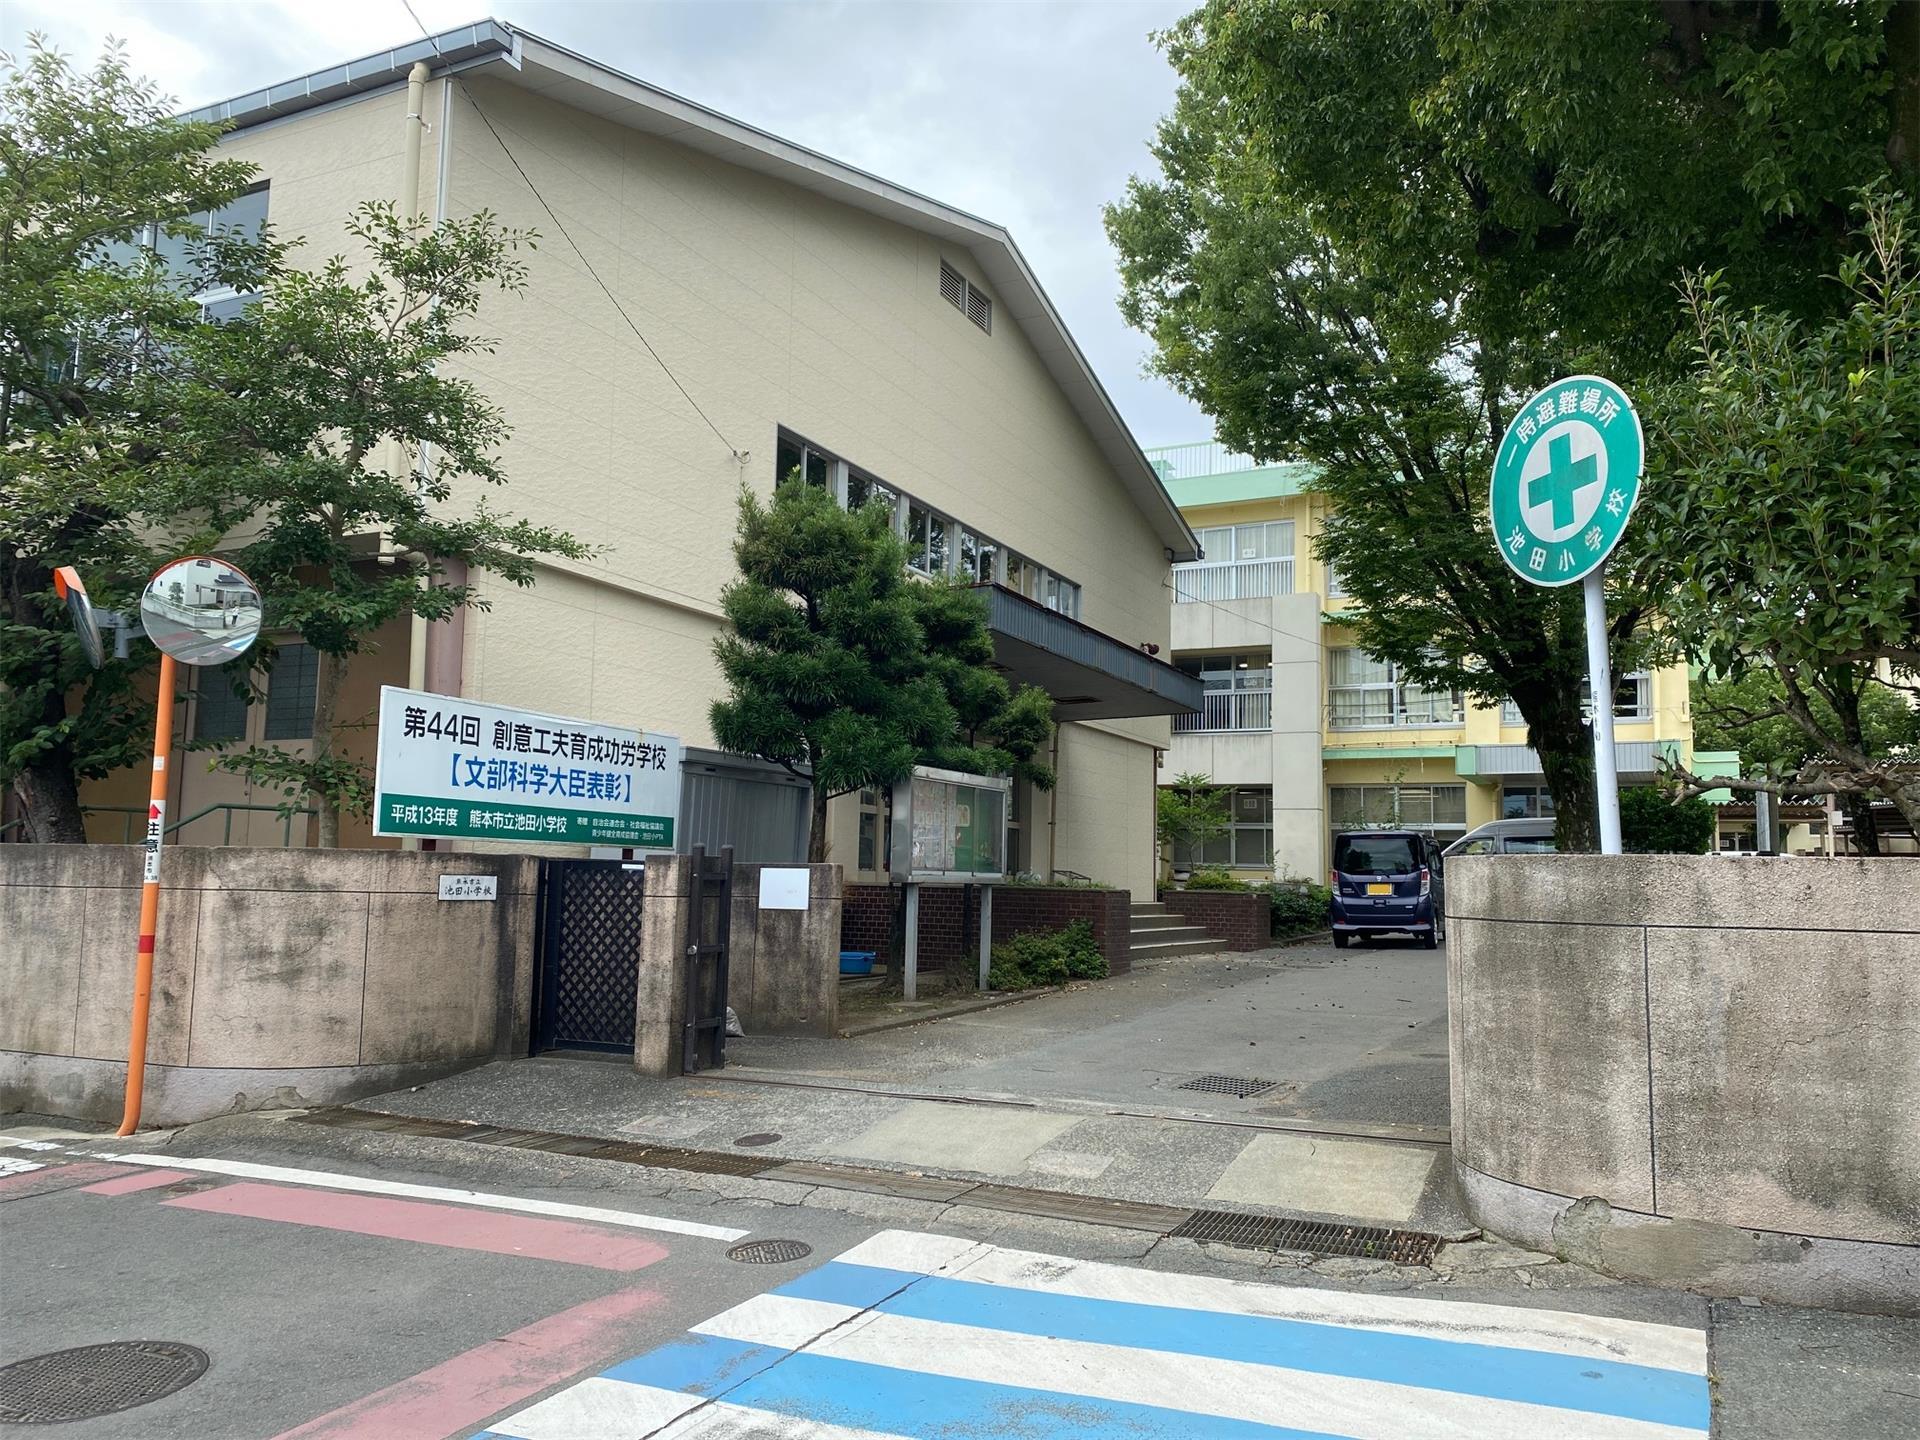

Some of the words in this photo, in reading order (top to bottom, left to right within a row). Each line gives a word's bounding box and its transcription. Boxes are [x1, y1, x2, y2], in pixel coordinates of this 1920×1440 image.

[1506, 386, 1622, 468] 一時避難場所
[1505, 487, 1628, 572] 池田小学校
[403, 705, 482, 747] 第44回
[492, 719, 667, 771] 創意工夫育成功労学校
[450, 753, 632, 803] 【文部科学大臣表彰】
[390, 804, 459, 828] 平成13年度
[468, 809, 568, 834] 熊本市立池田小学校
[444, 885, 493, 897] 池田小学校
